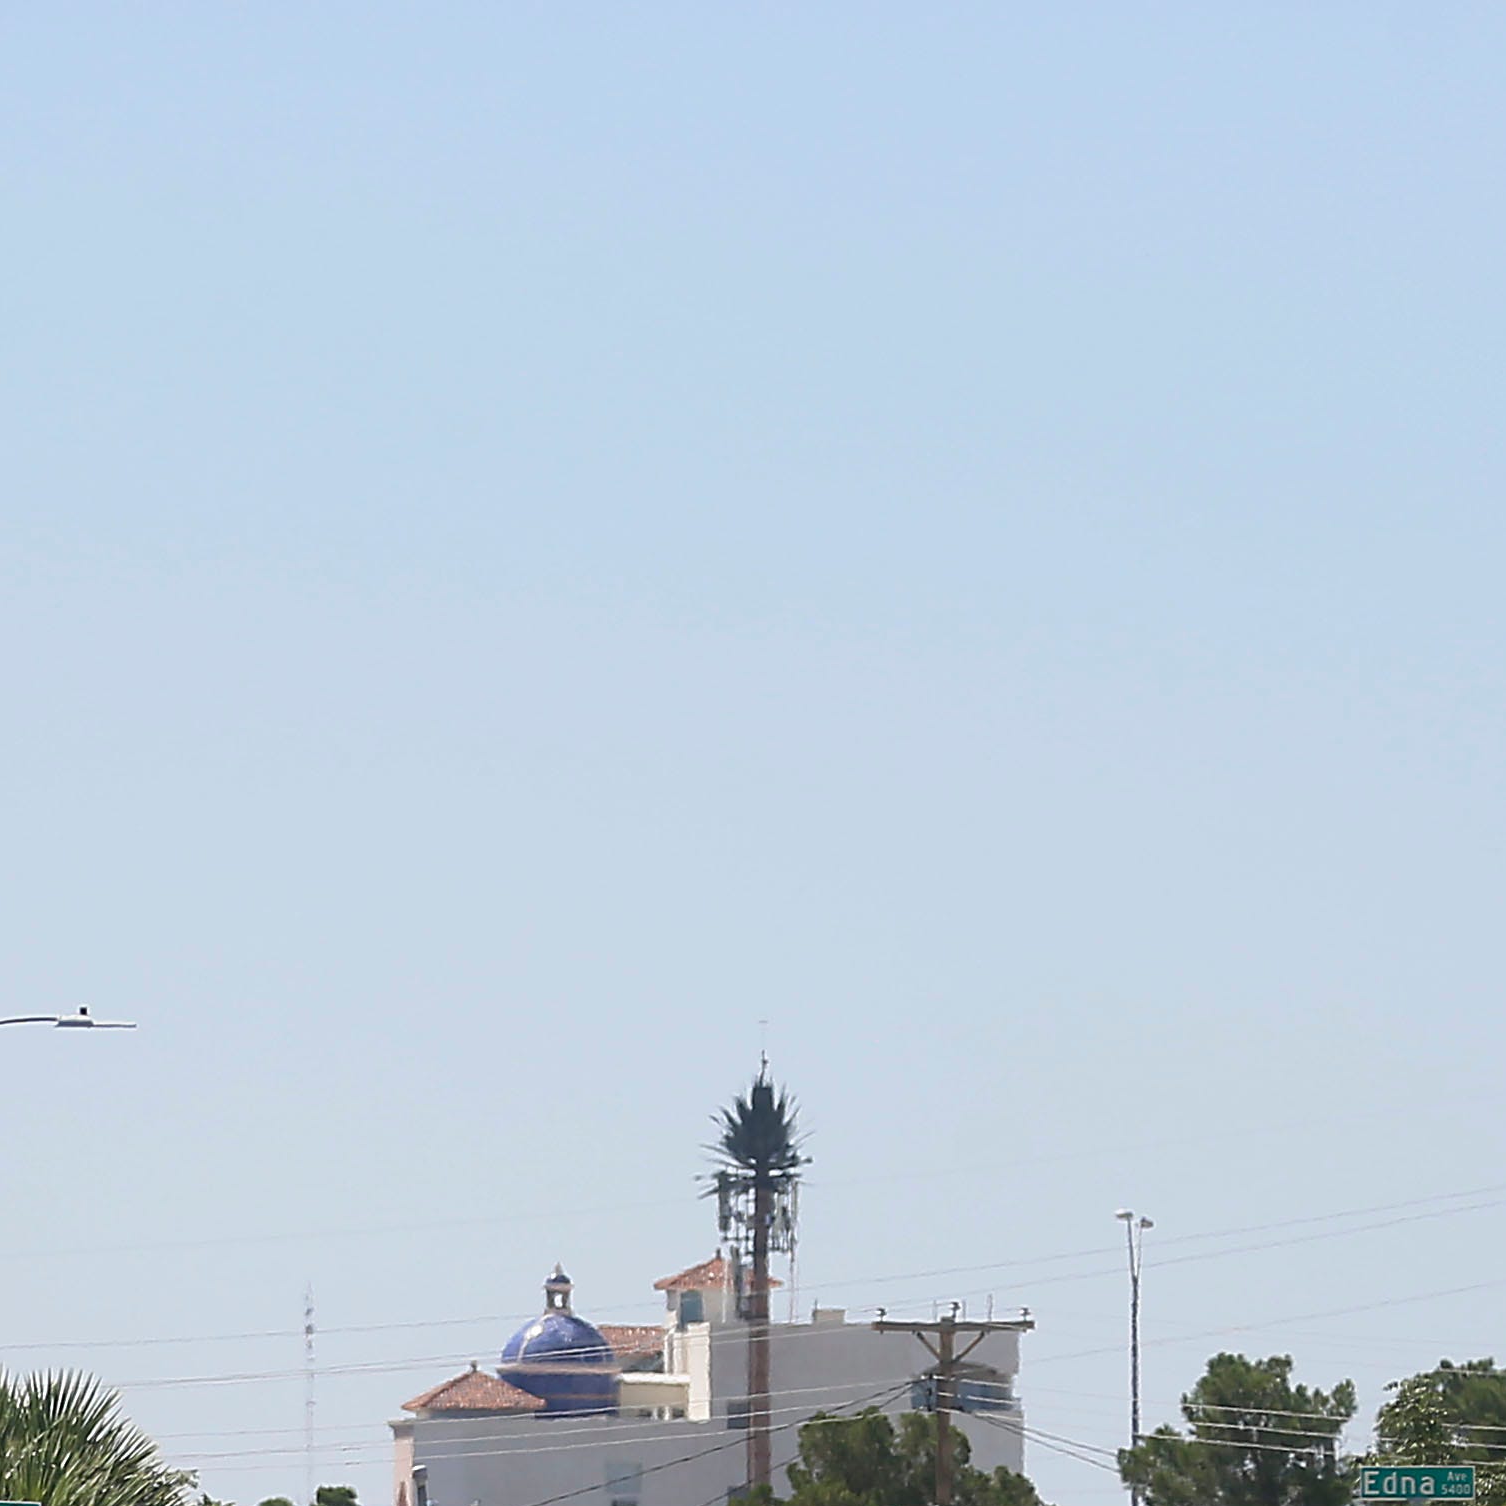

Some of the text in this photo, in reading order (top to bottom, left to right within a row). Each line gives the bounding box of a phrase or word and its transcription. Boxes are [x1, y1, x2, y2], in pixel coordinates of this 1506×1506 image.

[1363, 1470, 1468, 1495] Edna Ave
[1441, 1483, 1472, 1495] 5400
